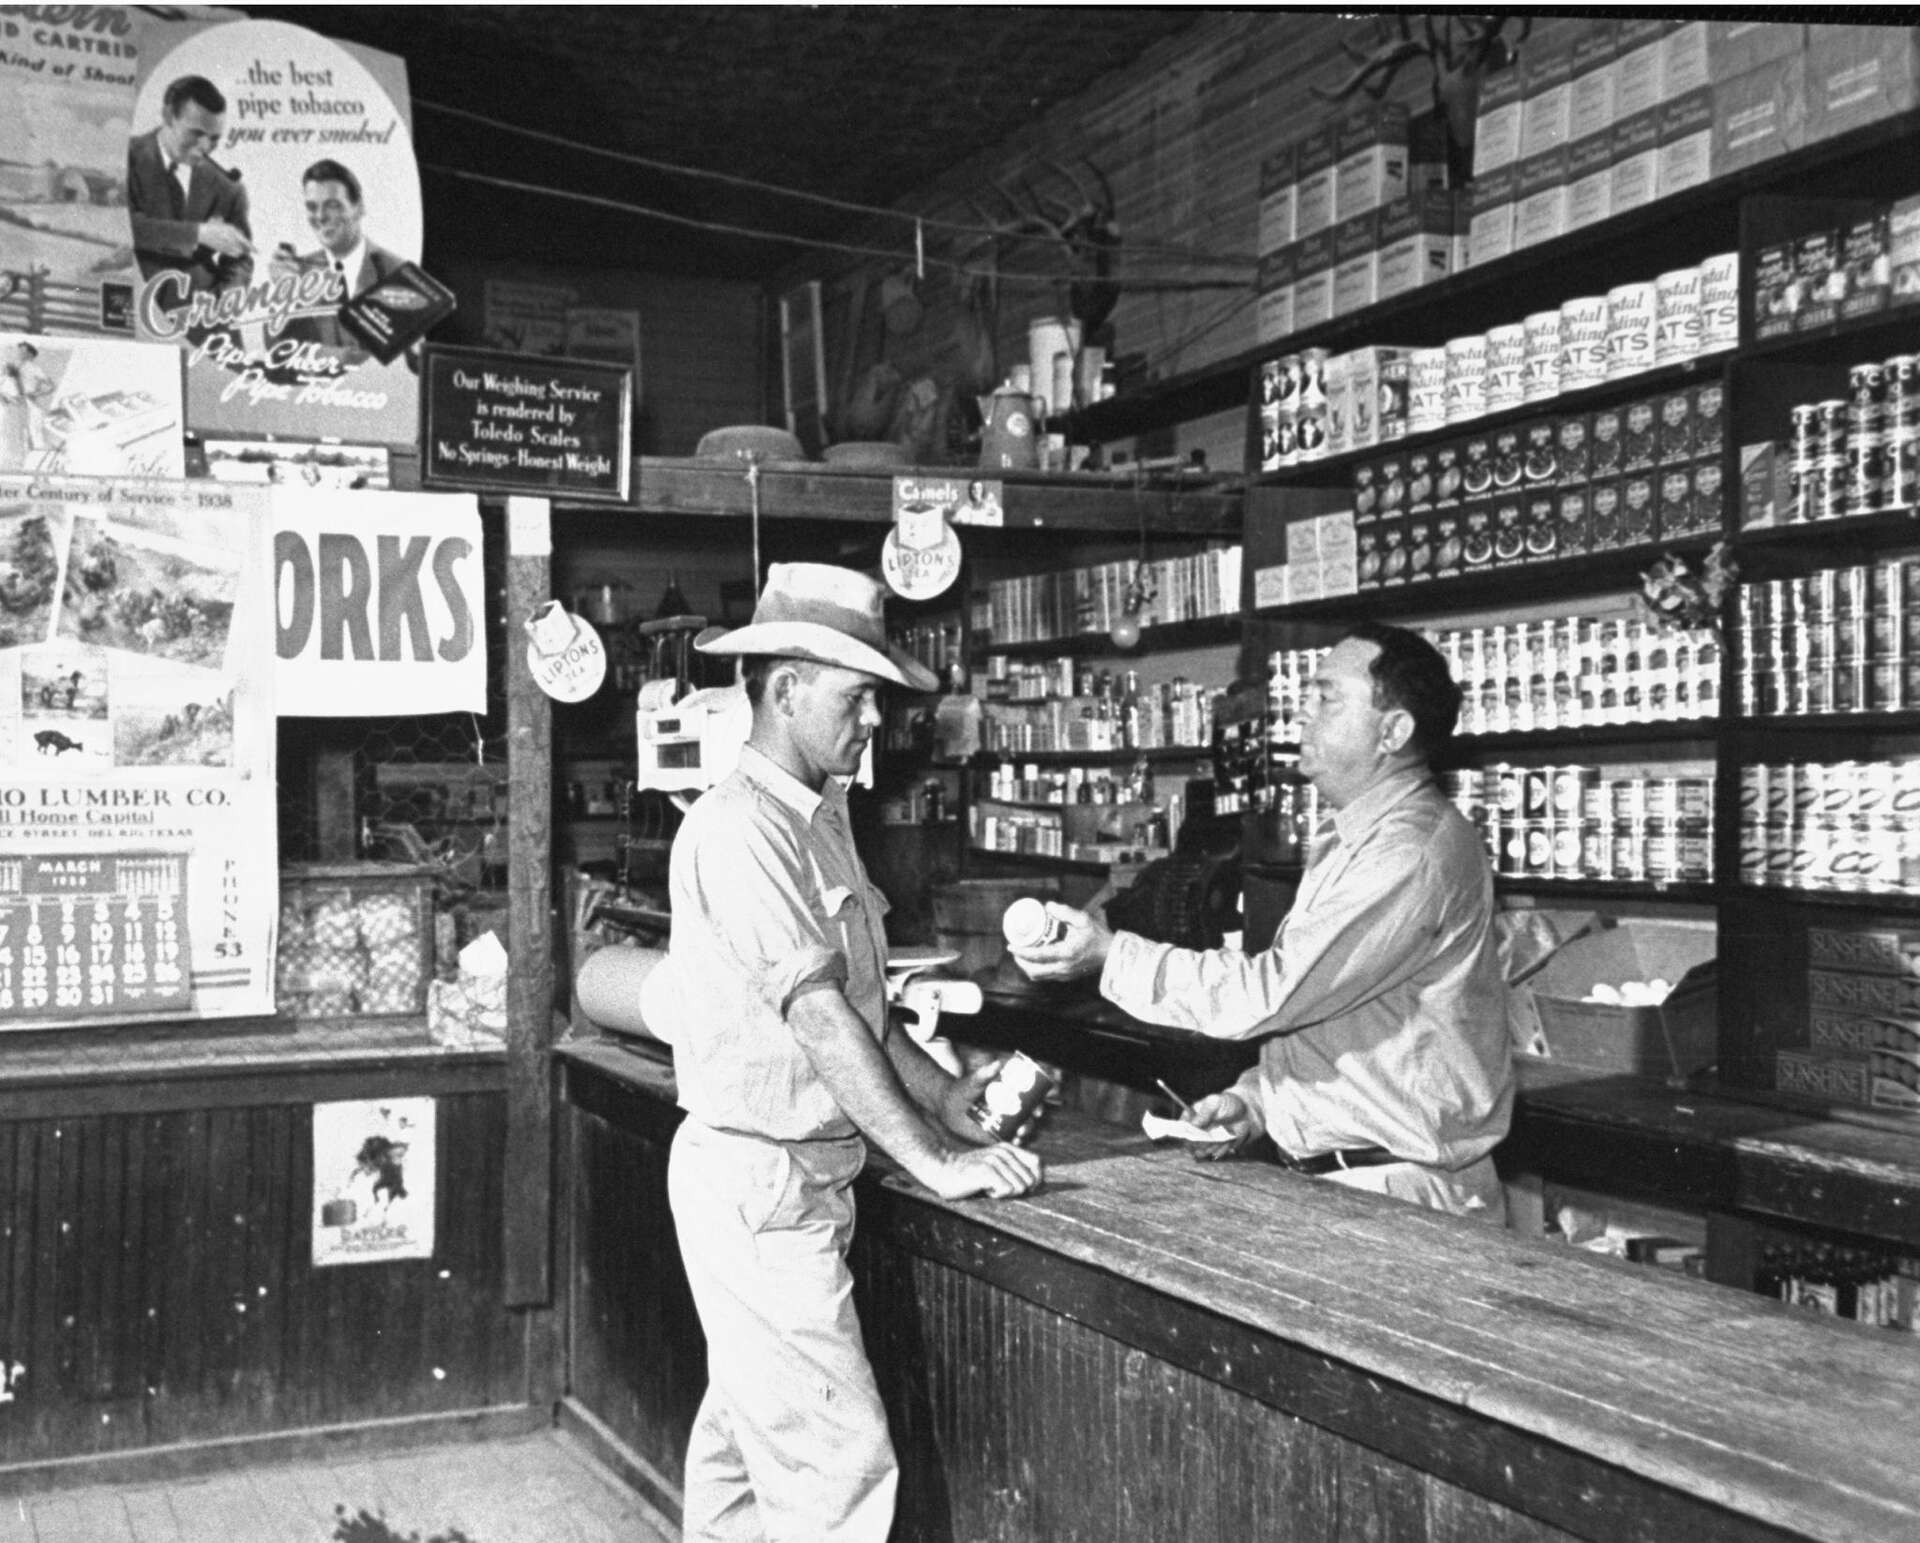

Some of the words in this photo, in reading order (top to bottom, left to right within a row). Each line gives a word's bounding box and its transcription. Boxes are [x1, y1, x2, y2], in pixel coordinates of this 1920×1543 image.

[32, 28, 138, 59] CARTRID
[289, 60, 333, 86] best
[237, 91, 282, 119] pipe
[290, 90, 365, 115] tobacco
[225, 127, 266, 149] you
[271, 129, 316, 144] ever
[318, 118, 397, 145] smoked
[138, 269, 345, 338] Granger
[1607, 332, 1649, 354] ATS
[1656, 319, 1704, 341] ATS
[1560, 345, 1606, 366] ATS
[453, 369, 480, 390] Our
[483, 371, 546, 400] Weighing
[550, 380, 601, 402] Service
[477, 398, 489, 416] is
[492, 401, 555, 423] rendered
[558, 404, 576, 427] by
[472, 419, 523, 442] Toledo
[530, 425, 581, 449] Scales
[438, 441, 457, 461] No
[458, 442, 509, 469] Springs
[566, 452, 611, 477] Weight
[26, 483, 89, 503] Century
[97, 487, 113, 503] of
[273, 530, 476, 663] ORKS
[40, 788, 173, 807] LUMBER
[186, 788, 232, 808] CO.
[20, 810, 79, 825] Home
[86, 809, 155, 829] Capital
[38, 862, 101, 873] MARCH
[124, 901, 142, 921] 4
[91, 923, 113, 943] 10
[124, 922, 142, 942] 11
[0, 947, 14, 966] 4
[23, 946, 48, 966] 15
[57, 944, 81, 967] 16
[91, 943, 113, 964] 17
[157, 941, 179, 962] 19
[213, 941, 243, 960] 53
[22, 987, 48, 1008] 29
[90, 985, 113, 1005] 31
[1814, 976, 1896, 1009] SUNSHINE
[1815, 1019, 1867, 1048] SUNSH
[1781, 1062, 1860, 1097] SUNSHINE
